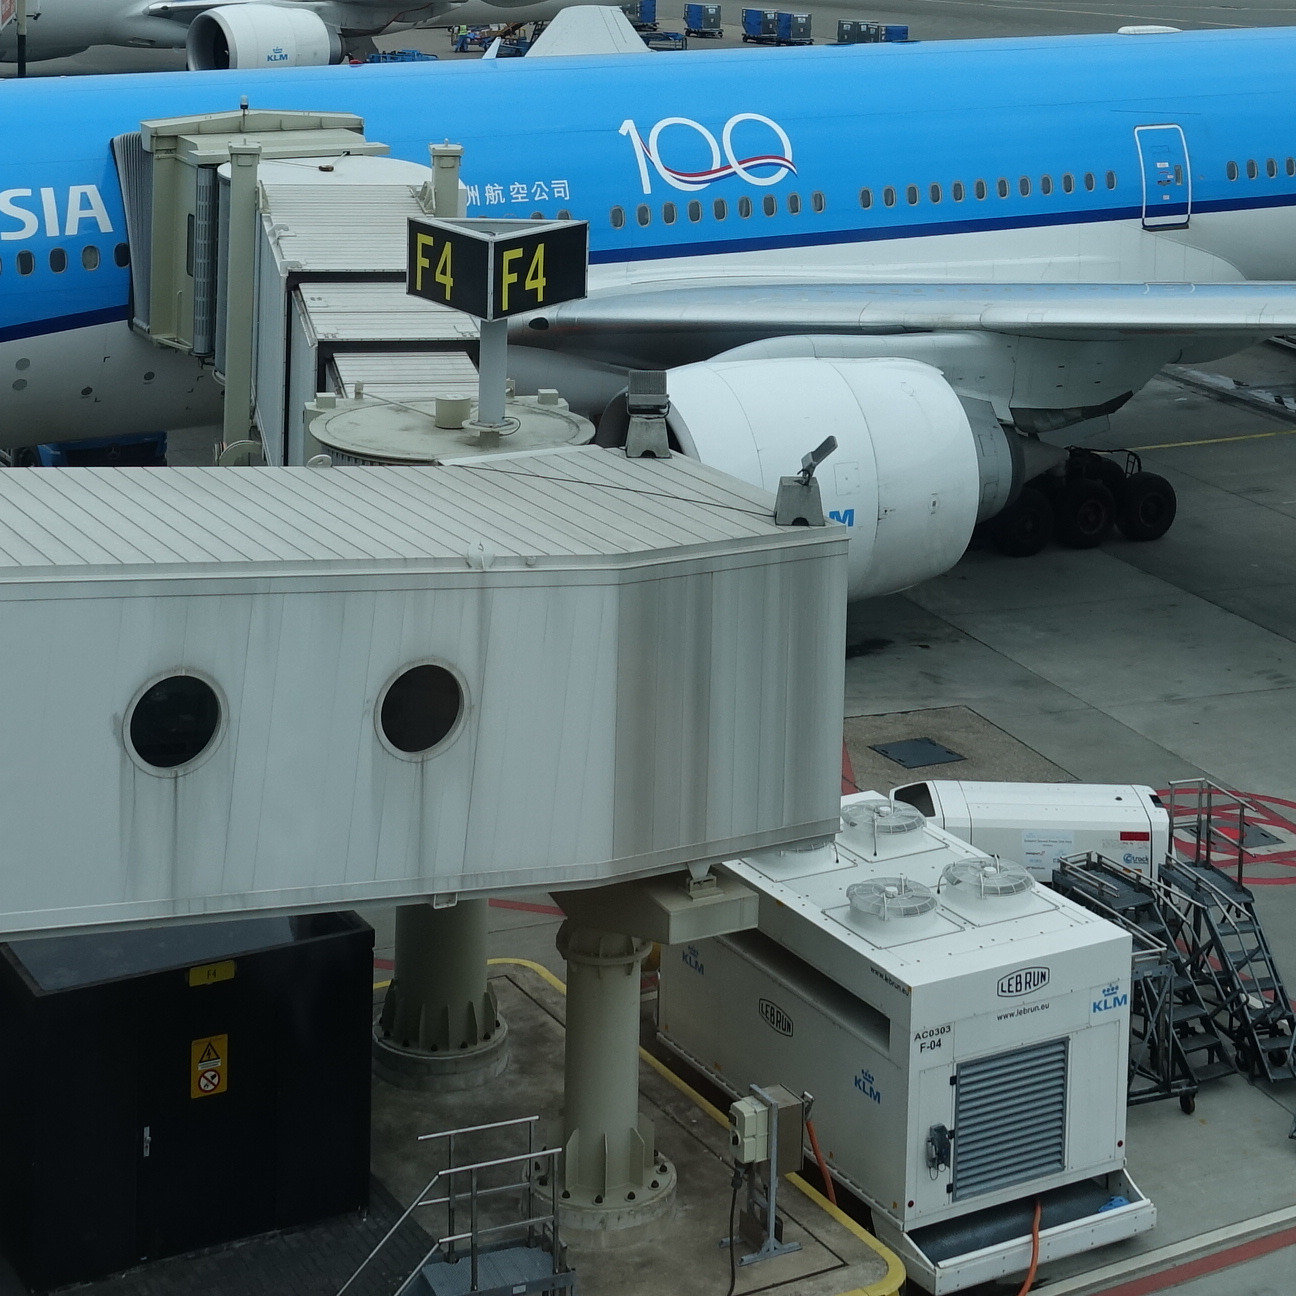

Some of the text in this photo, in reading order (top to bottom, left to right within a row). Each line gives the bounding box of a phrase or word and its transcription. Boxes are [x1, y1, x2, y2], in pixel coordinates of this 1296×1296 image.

[618, 112, 795, 194] 100
[416, 232, 454, 301] F4
[502, 243, 546, 311] F4
[207, 969, 217, 979] F4
[682, 951, 704, 976] KLM
[1000, 971, 1047, 993] LEBRUN
[997, 1003, 1050, 1021] www.lebrun.eu
[1092, 994, 1127, 1013] KLM
[761, 1001, 791, 1034] LEBRUN
[914, 1025, 951, 1041] AC0303
[920, 1038, 942, 1053] F-04
[854, 1075, 881, 1104] KLM
